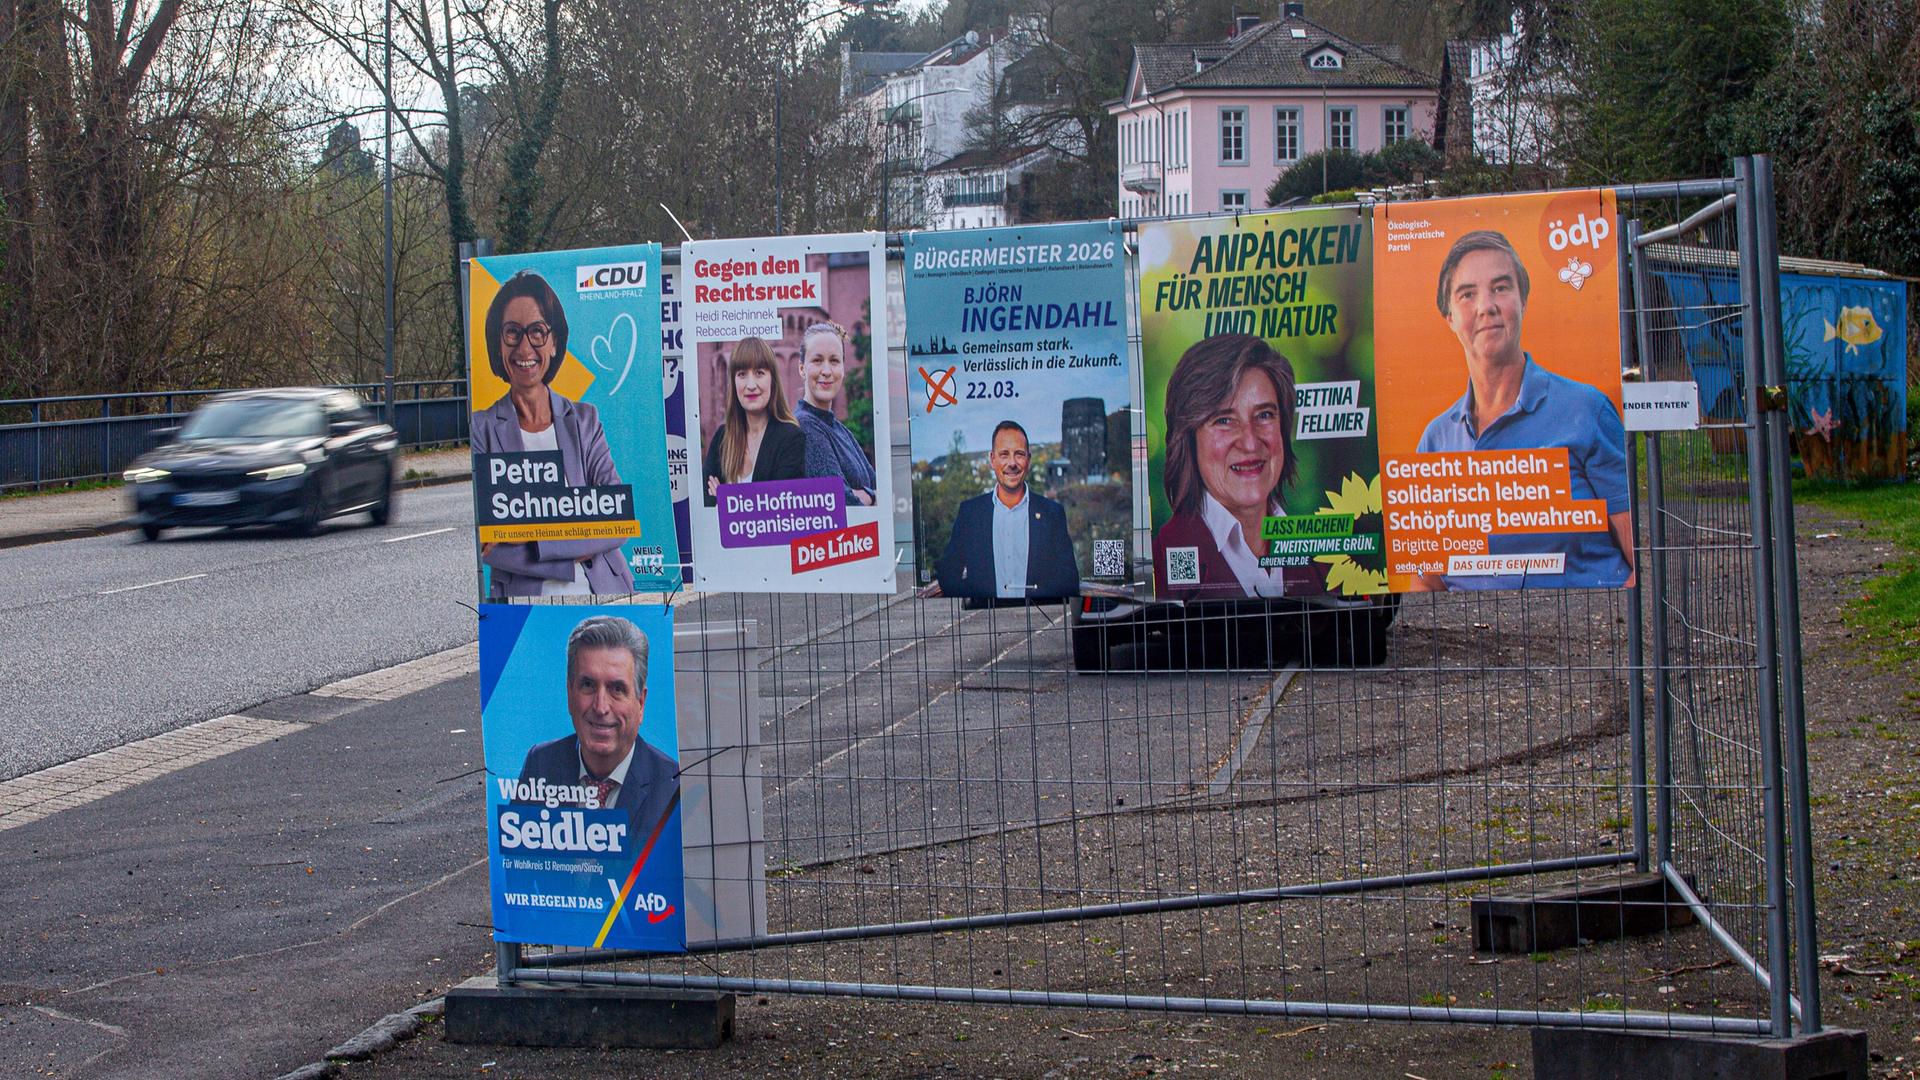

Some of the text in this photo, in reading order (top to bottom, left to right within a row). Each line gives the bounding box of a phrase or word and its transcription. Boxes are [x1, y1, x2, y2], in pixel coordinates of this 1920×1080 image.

[1388, 219, 1432, 231] Ökologisch-
[1388, 229, 1445, 241] Demokratische
[1549, 213, 1609, 251] ödp
[914, 242, 1114, 270] BÜRGERMEISTER 2026
[1189, 224, 1362, 275] ANPACKEN
[1388, 243, 1411, 252] Partei
[594, 266, 643, 287] CDU
[694, 255, 800, 282] Gegen den
[579, 289, 643, 302] RHEINLAND-PFALZ
[695, 279, 816, 303] Rechtsruck
[964, 283, 1022, 304] BJÖRN
[1155, 271, 1307, 312] FÜR MENSCH
[695, 307, 774, 322] Heidi Reichinnek
[962, 301, 1117, 333] INGENDAHL
[1204, 303, 1337, 340] UND NATUR
[695, 324, 779, 338] Rebecca Ruppert
[963, 337, 1073, 354] Gemeinsam stark.
[964, 353, 1122, 373] Verlässlich in die Zukunft.
[966, 381, 1019, 399] 22.03.
[1296, 386, 1352, 407] BETTINA
[1623, 402, 1652, 410] ENDER
[1301, 412, 1364, 433] FELLMER
[490, 458, 559, 485] Petra
[1386, 457, 1462, 479] Gerecht
[1467, 454, 1548, 476] handeln
[727, 491, 836, 513] Die Hoffnung
[1387, 480, 1490, 505] solidarisch
[1496, 481, 1550, 501] leben
[492, 488, 626, 520] Schneider
[729, 514, 838, 538] organisieren.
[1265, 517, 1350, 535] LASS MACHEN!
[1389, 506, 1602, 534] Schöpfung bewahren.
[493, 525, 636, 539] Für unsere Heimat schlägt mein Herz!
[798, 533, 873, 565] Die Linke
[1274, 535, 1376, 554] ZWEITSTIMME GRÜN.
[1392, 537, 1484, 554] Brigitte Doege
[629, 555, 664, 566] JETZT
[1260, 556, 1310, 567] GRUENE-RLP.DE
[1395, 561, 1444, 573] oedp-rlp.de
[1453, 558, 1559, 570] DAS GUTE GEWINNT!
[498, 778, 600, 809] Wolfgang
[500, 810, 626, 852] Seidler
[502, 859, 512, 868] Für
[514, 859, 543, 870] Wahlkreis
[552, 861, 604, 875] Remagen/Sinzig
[504, 893, 603, 910] WIR REGELN DAS
[635, 893, 666, 912] AfD
